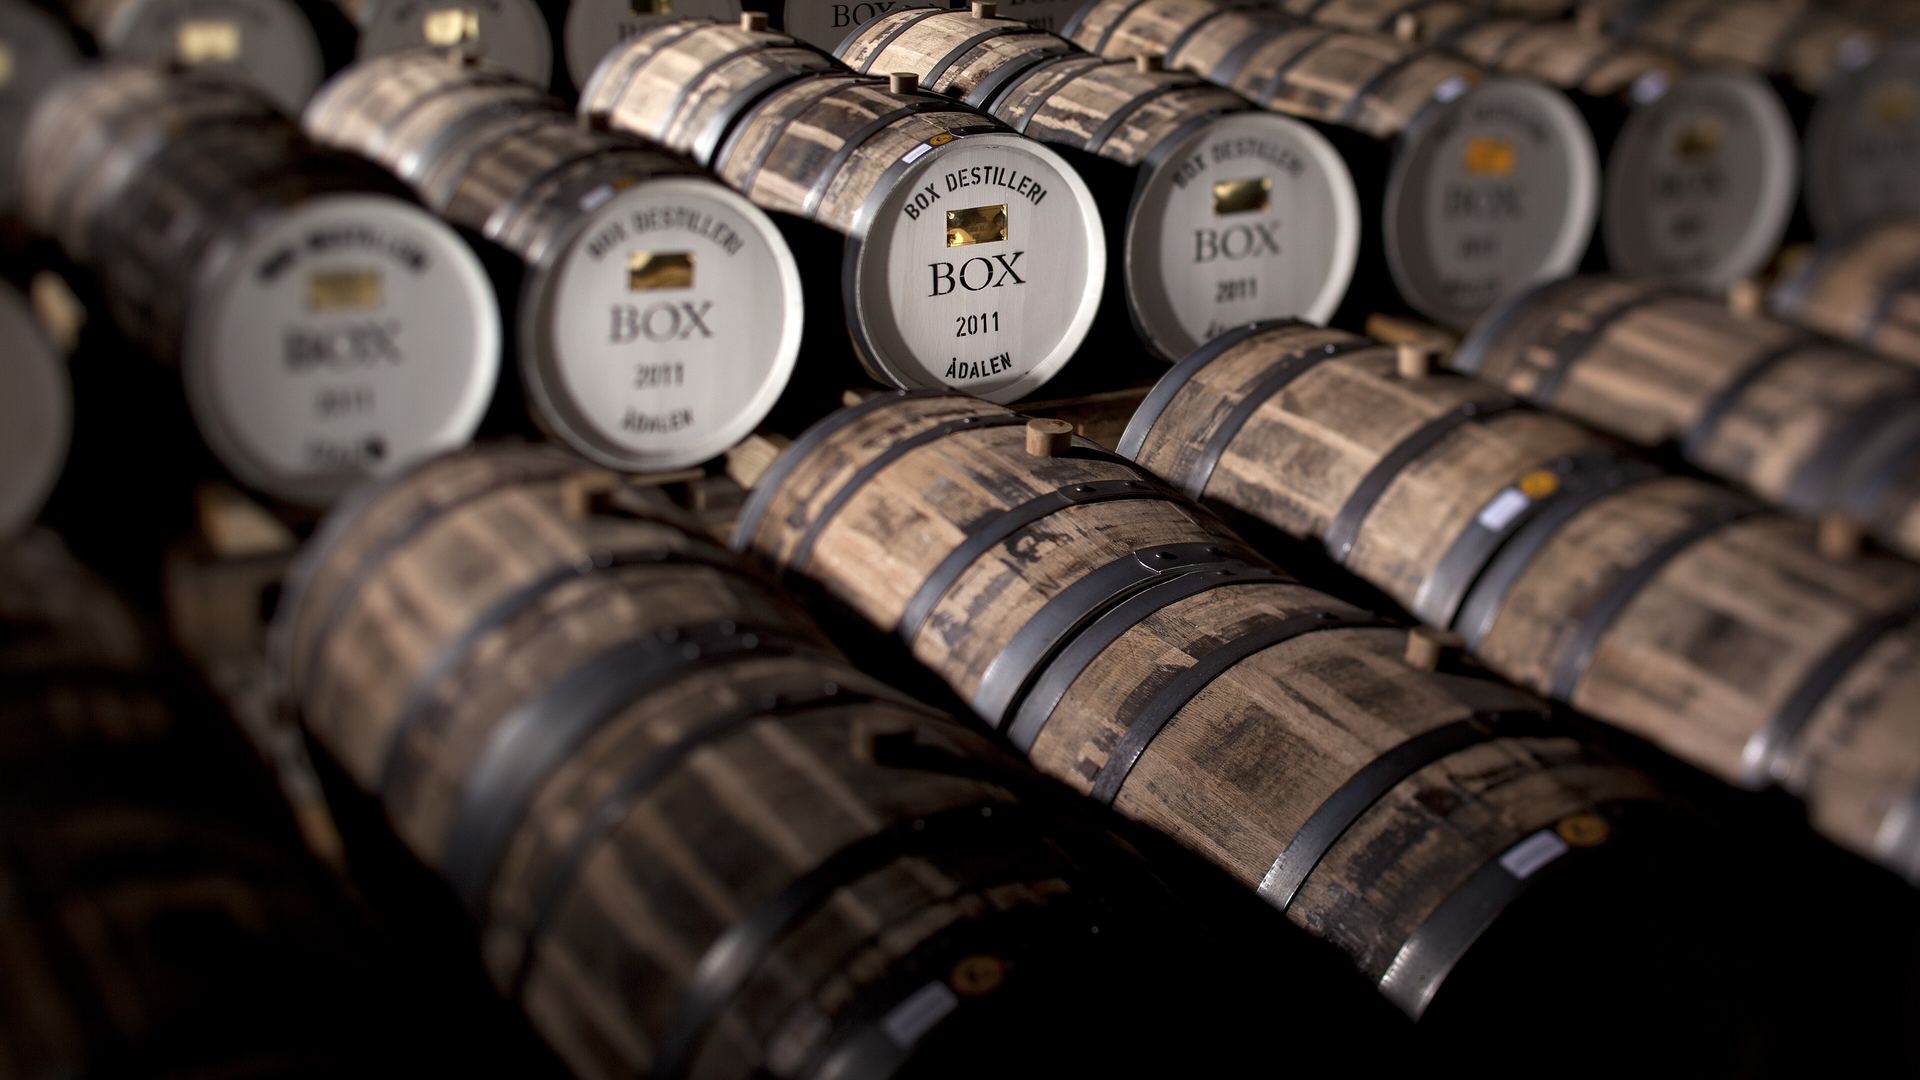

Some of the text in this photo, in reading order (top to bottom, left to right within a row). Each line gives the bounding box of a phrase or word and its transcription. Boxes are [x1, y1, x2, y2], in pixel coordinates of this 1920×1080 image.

[904, 165, 1048, 221] BOX DESTILLERI
[1193, 221, 1280, 263] BOX
[927, 251, 1027, 298] BOX
[1217, 279, 1258, 303] 2011
[609, 302, 713, 344] BOX
[955, 311, 1000, 338] 2011
[945, 352, 1013, 379] ÅDALEN
